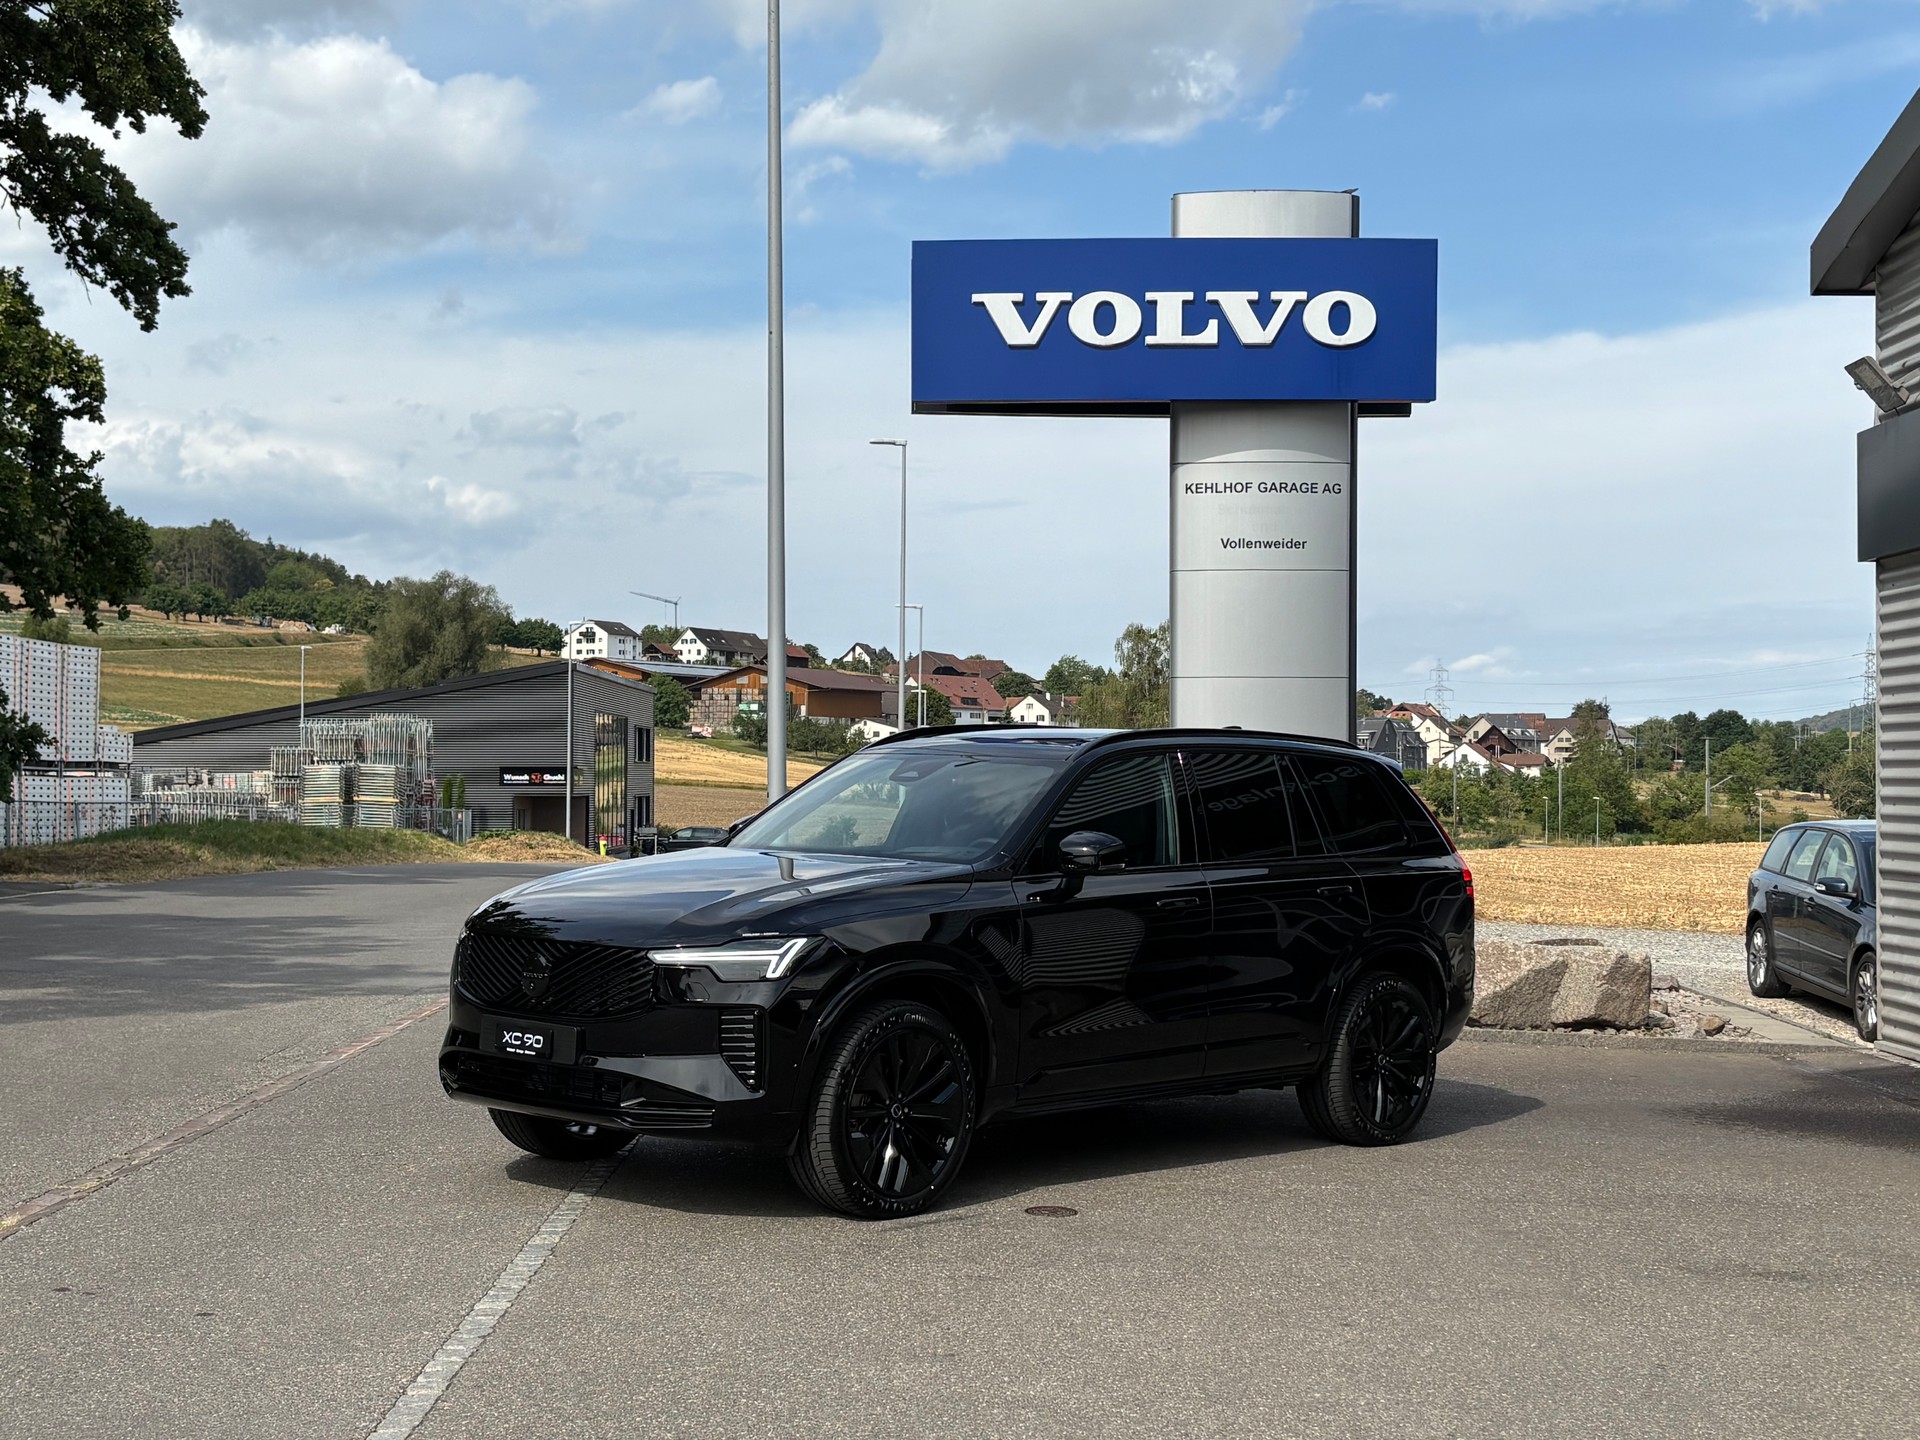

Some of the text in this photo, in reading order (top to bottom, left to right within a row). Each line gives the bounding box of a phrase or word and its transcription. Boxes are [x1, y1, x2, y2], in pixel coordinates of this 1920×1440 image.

[971, 290, 1377, 346] VOLVO
[1185, 482, 1342, 495] KEHLHOF GARAGE AG
[1220, 537, 1307, 550] Vollenweider
[502, 1030, 544, 1048] XC90
